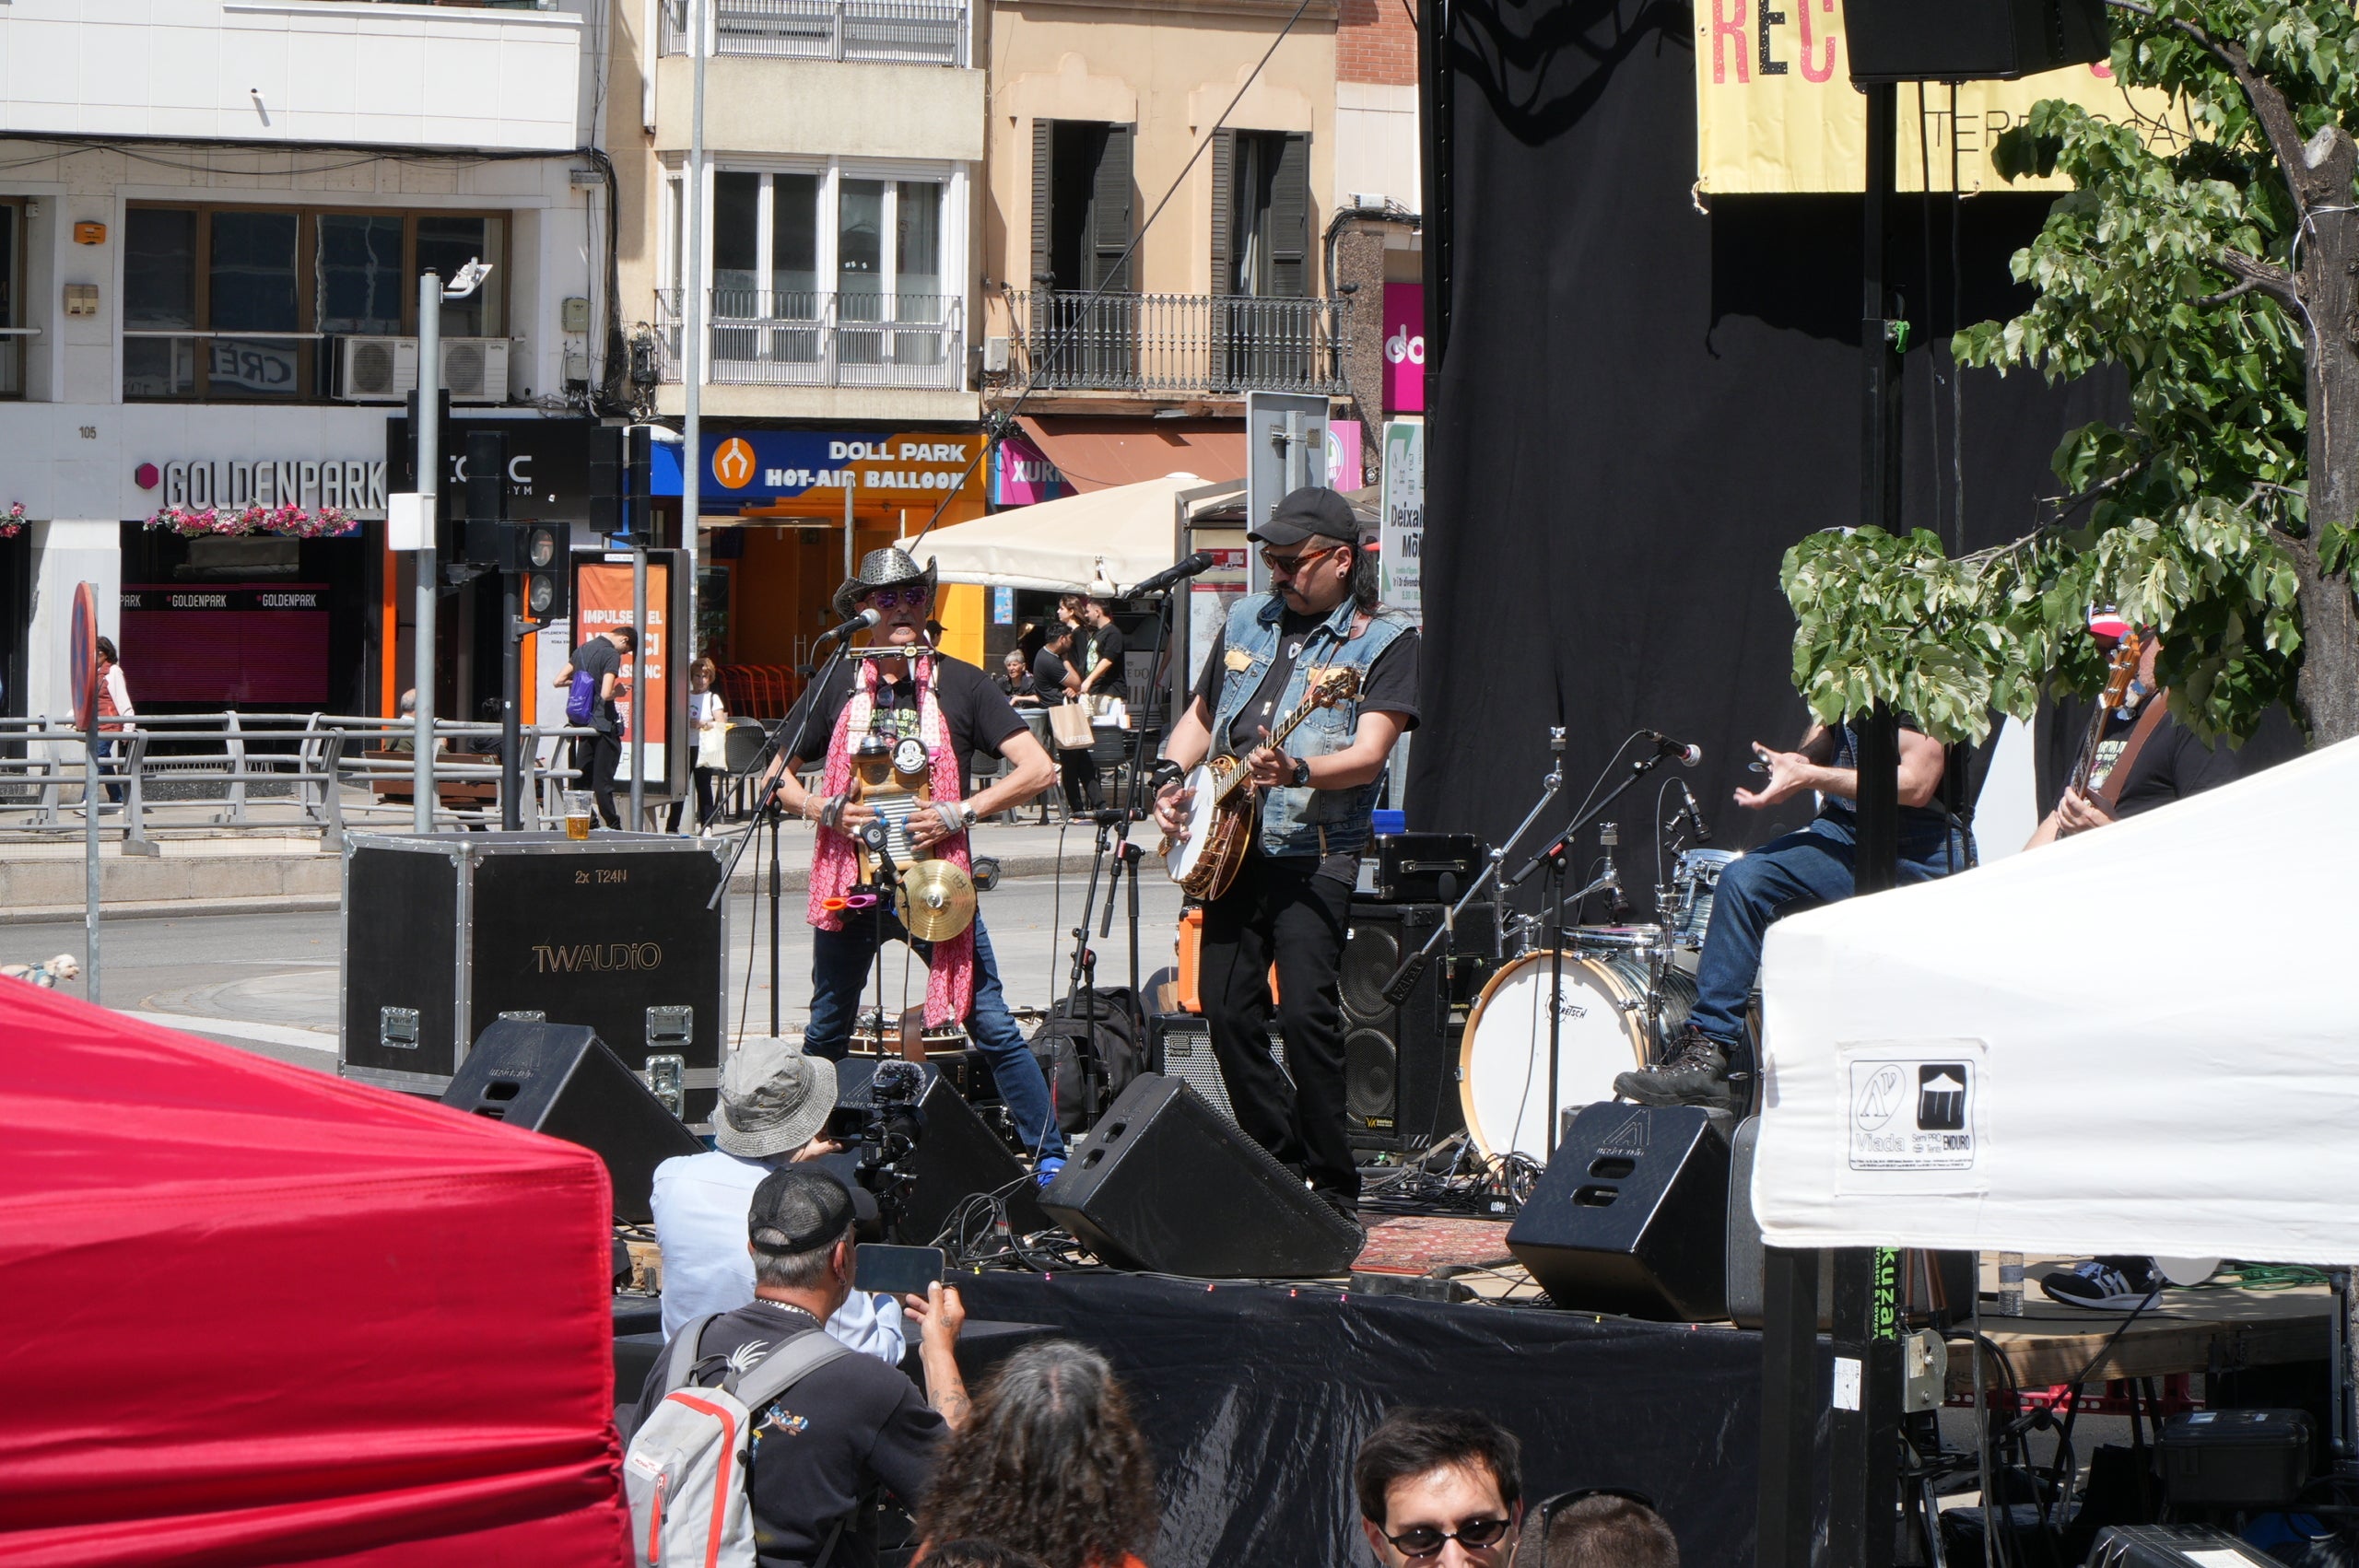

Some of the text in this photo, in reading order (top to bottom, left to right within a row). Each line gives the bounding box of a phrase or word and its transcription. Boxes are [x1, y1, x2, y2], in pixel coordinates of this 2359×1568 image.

[78, 426, 97, 439] 105
[828, 441, 967, 462] DOLL PARK
[164, 461, 387, 510] GOLDENPARK
[765, 468, 966, 490] HOT-AIR BALLOON
[171, 593, 227, 608] GOLDENPARK
[262, 592, 317, 607] GOLDENPARK
[582, 609, 663, 625] IMPULSE EL
[574, 869, 627, 884] 2x T24N
[1855, 1132, 1906, 1153] Viada
[1942, 1134, 1970, 1151] ENDURO
[1880, 1246, 1900, 1341] kuzar
